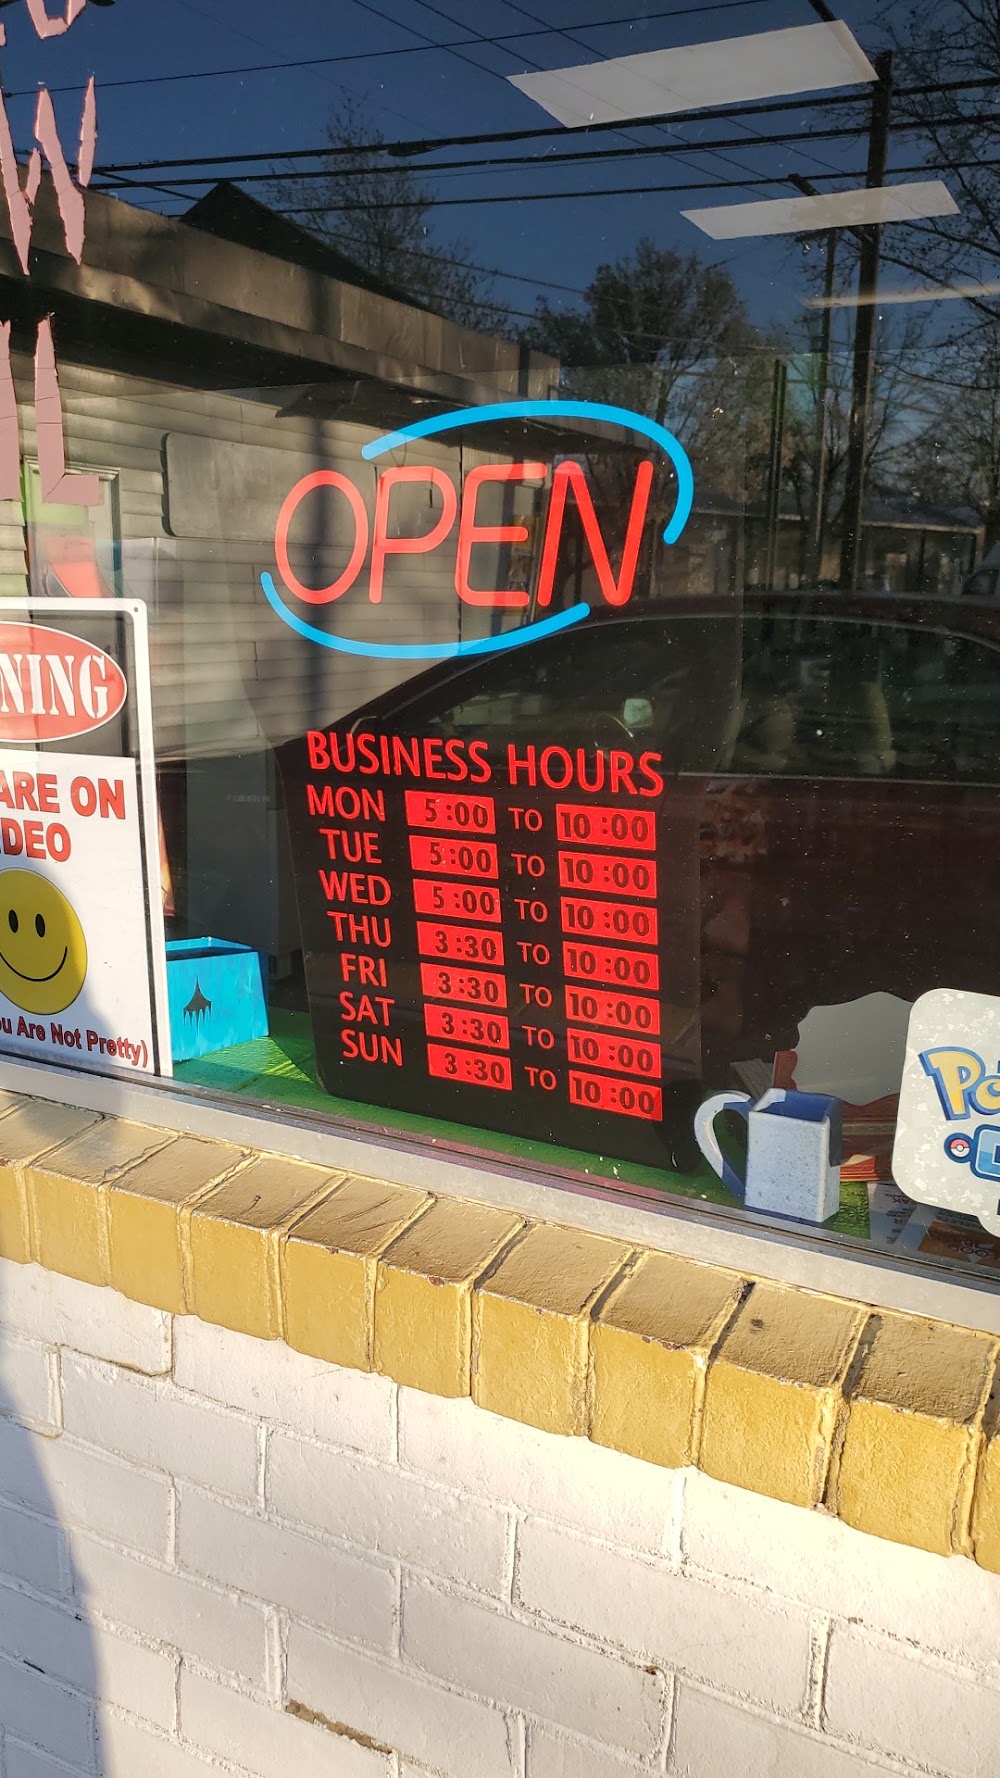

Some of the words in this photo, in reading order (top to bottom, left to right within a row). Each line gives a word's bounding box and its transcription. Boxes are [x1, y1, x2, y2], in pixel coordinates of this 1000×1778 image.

[274, 459, 654, 608] OPEN
[306, 730, 492, 783] BUSINESS
[507, 743, 664, 798] HOURS
[70, 775, 126, 820] ON
[306, 784, 386, 822] MON
[507, 807, 543, 832] TO
[319, 828, 382, 864] TUE
[511, 853, 546, 877] TO
[318, 869, 392, 907] WED
[513, 898, 548, 923] TO
[326, 910, 392, 948] THU
[517, 941, 550, 966] TO
[340, 952, 387, 988] FRI
[519, 983, 553, 1008] TO
[17, 1016, 46, 1041] Are
[50, 1022, 83, 1050] Not
[86, 1029, 149, 1069] Pretty)
[339, 991, 395, 1027] SAT
[521, 1025, 555, 1050] TO
[340, 1028, 403, 1067] SUN
[524, 1066, 557, 1091] TO
